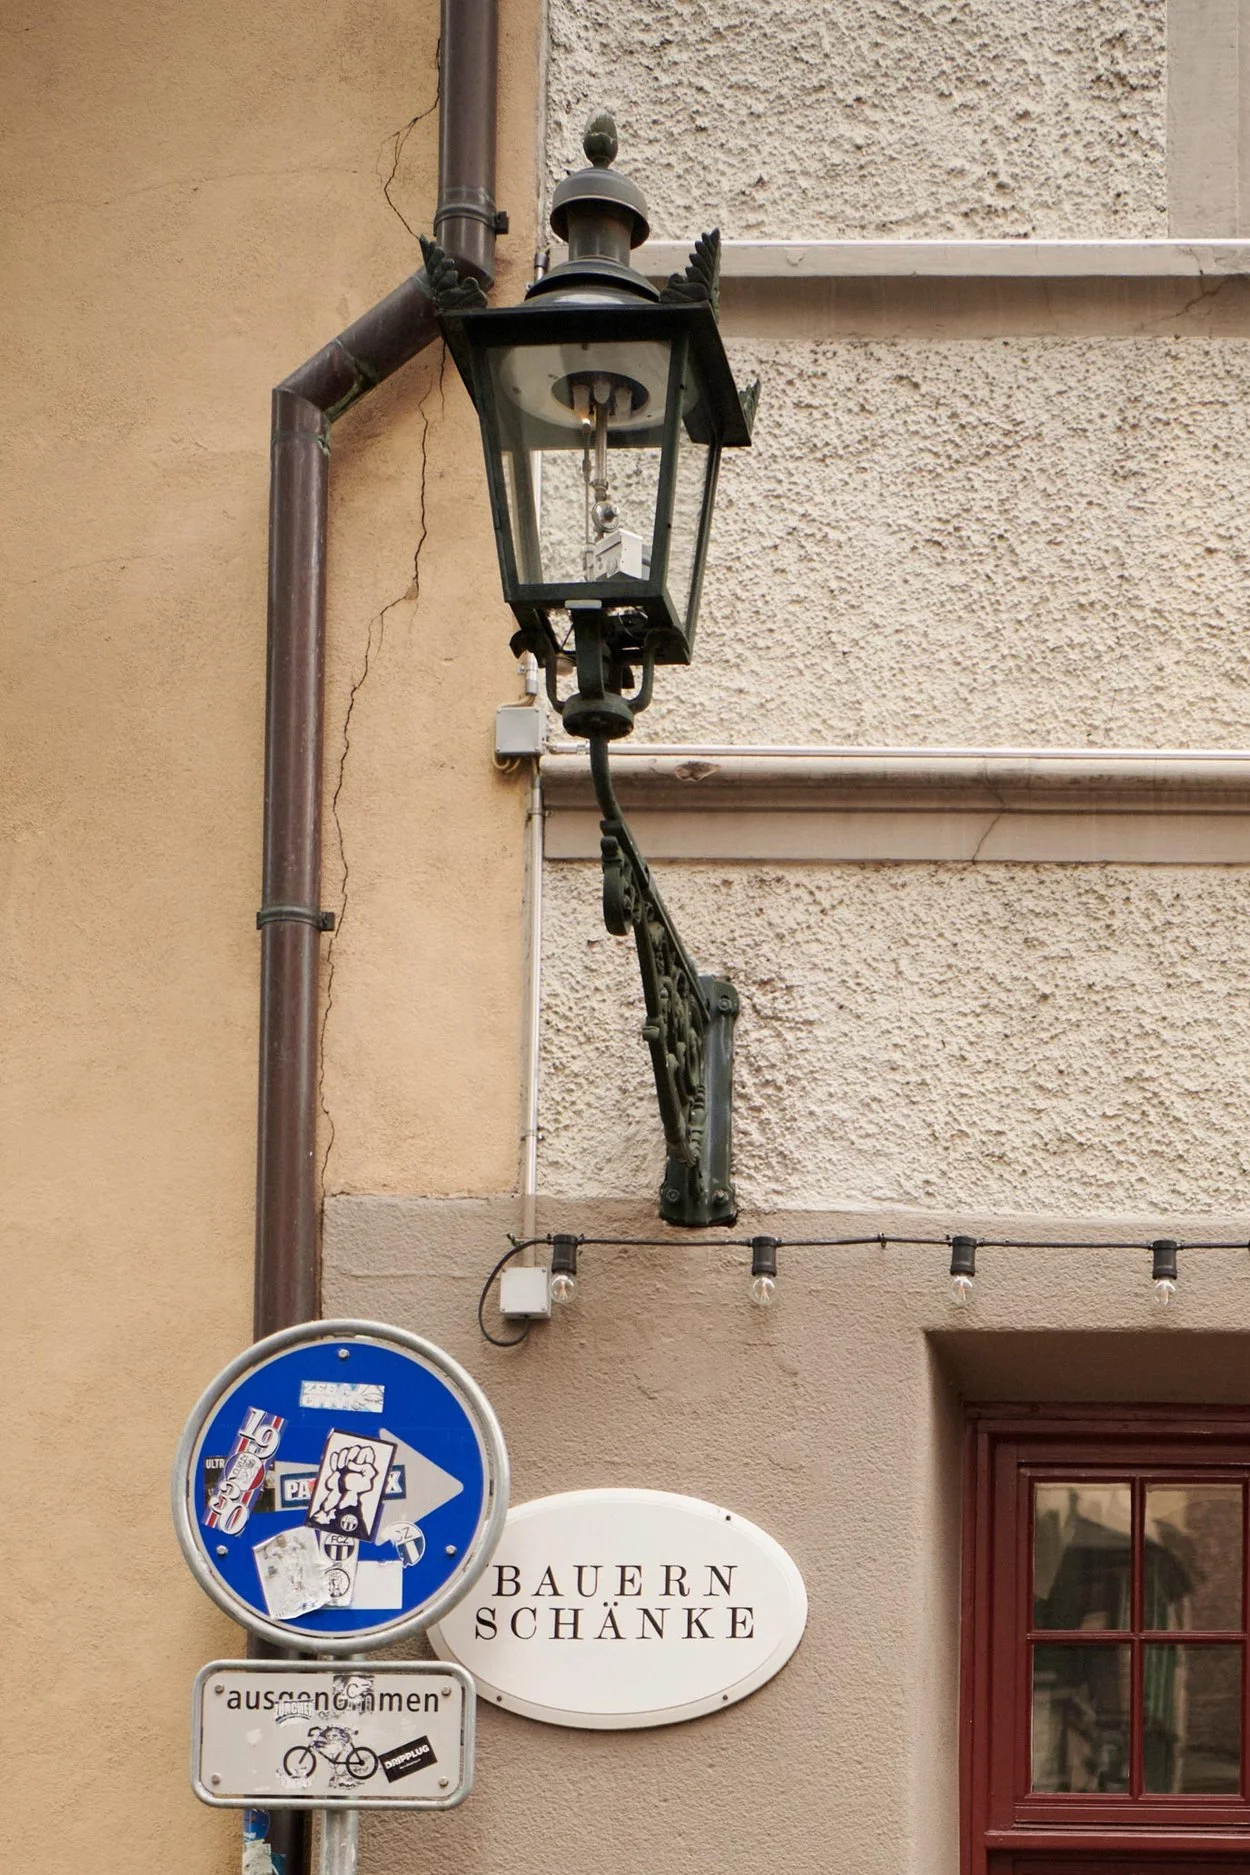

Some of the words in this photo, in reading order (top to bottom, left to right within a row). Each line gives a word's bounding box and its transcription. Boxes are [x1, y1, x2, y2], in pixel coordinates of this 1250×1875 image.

[330, 1535, 350, 1544] FCZ
[492, 1564, 739, 1598] BAUERN
[475, 1600, 754, 1641] SCHÄNKE
[384, 1744, 430, 1770] DRIPPLUG
